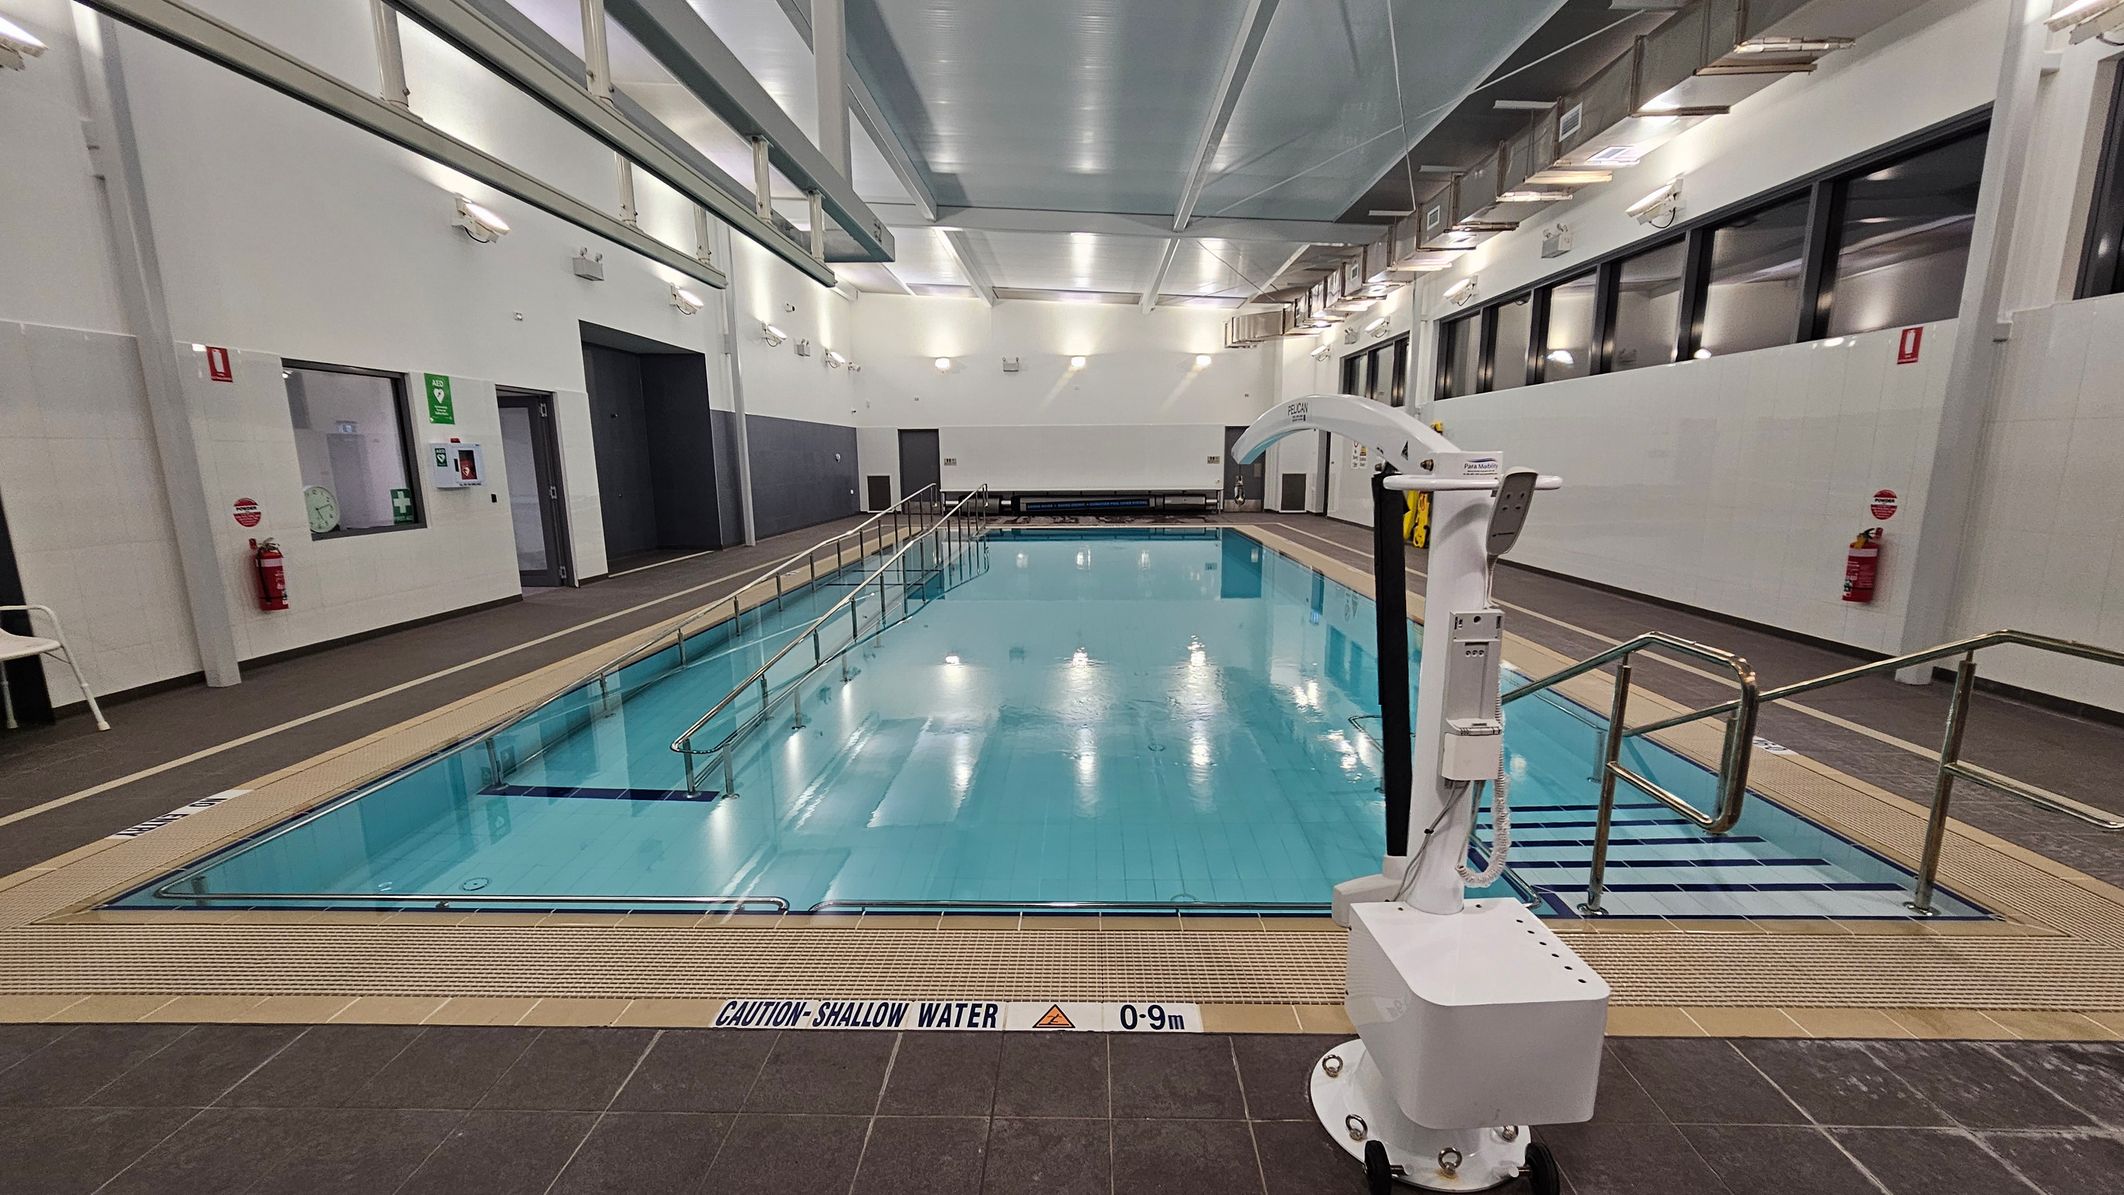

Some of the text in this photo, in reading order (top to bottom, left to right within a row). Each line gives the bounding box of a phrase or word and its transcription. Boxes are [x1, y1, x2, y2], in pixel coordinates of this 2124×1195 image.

[1288, 402, 1308, 416] PELICAN
[812, 1002, 910, 1028] SHALLOW
[918, 1002, 998, 1028] WATER
